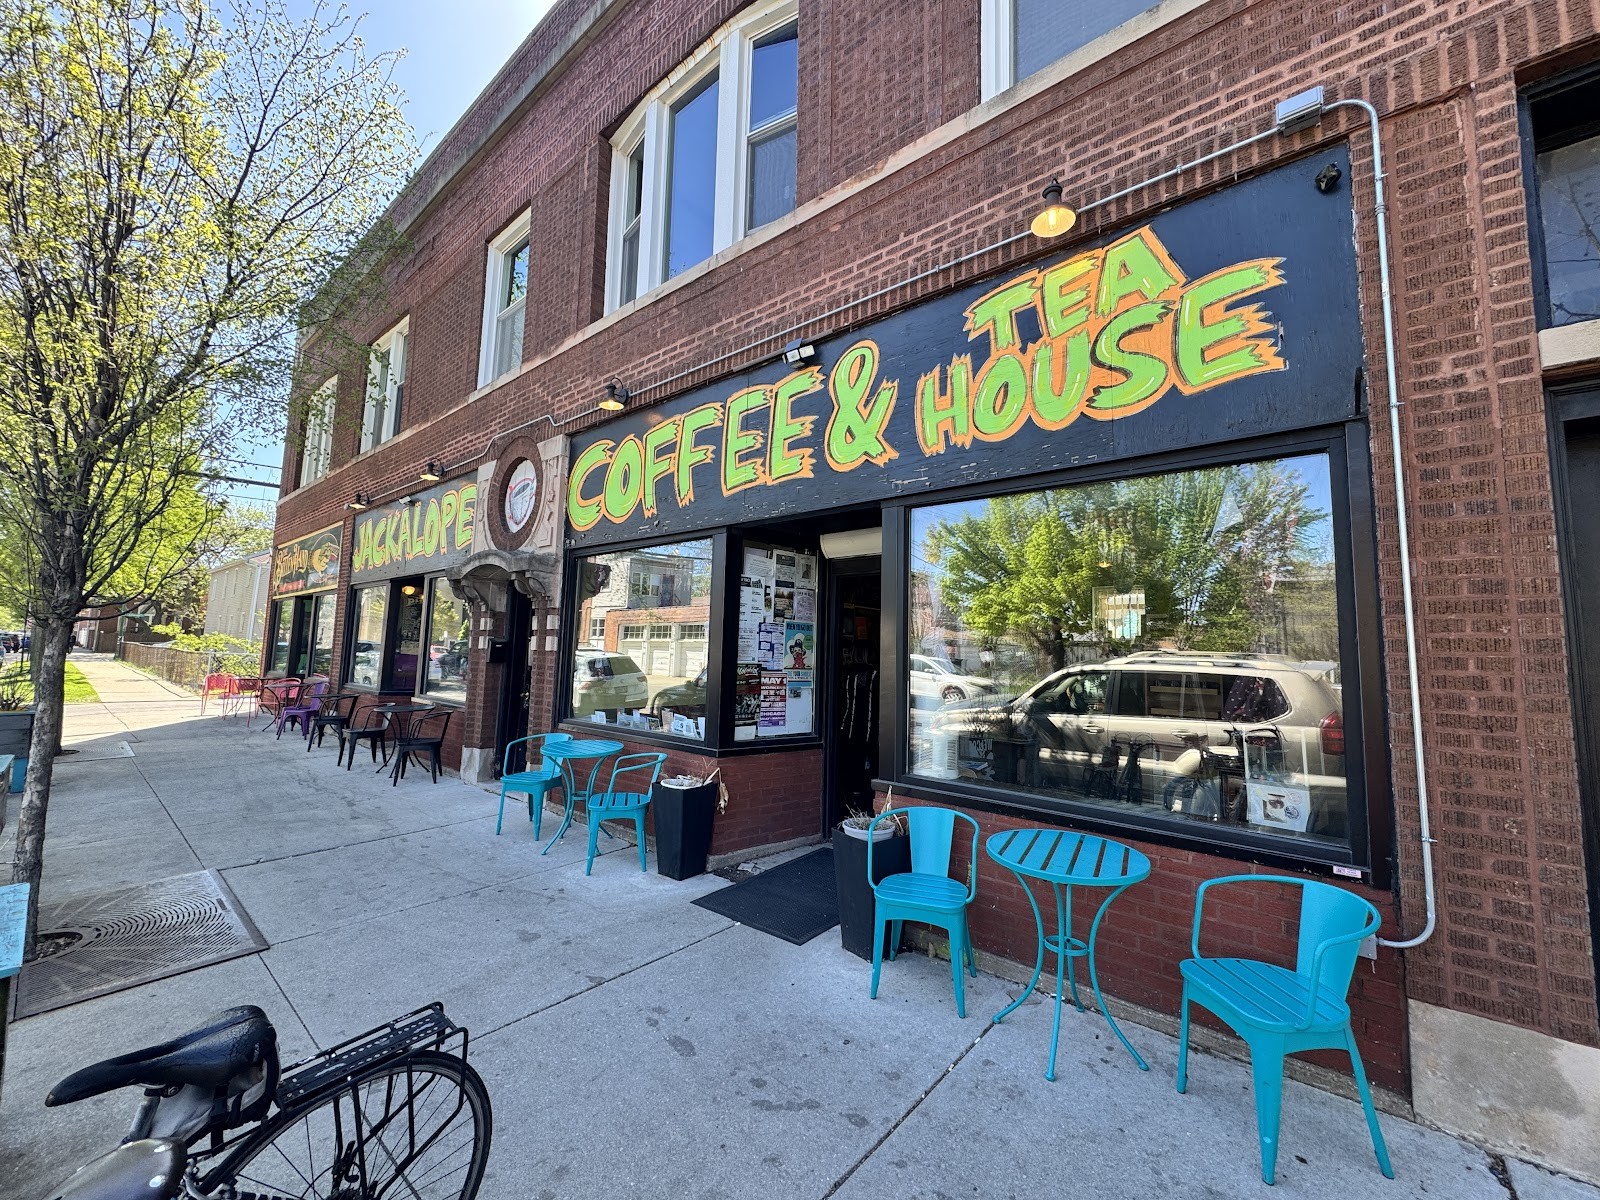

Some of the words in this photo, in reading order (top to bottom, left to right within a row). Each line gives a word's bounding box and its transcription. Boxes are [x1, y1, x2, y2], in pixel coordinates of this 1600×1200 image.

[963, 224, 1190, 353] TEA
[567, 366, 826, 531] COFFEE
[825, 340, 899, 472] &
[915, 257, 1288, 457] HOUSE
[353, 484, 477, 572] JACKALOPE
